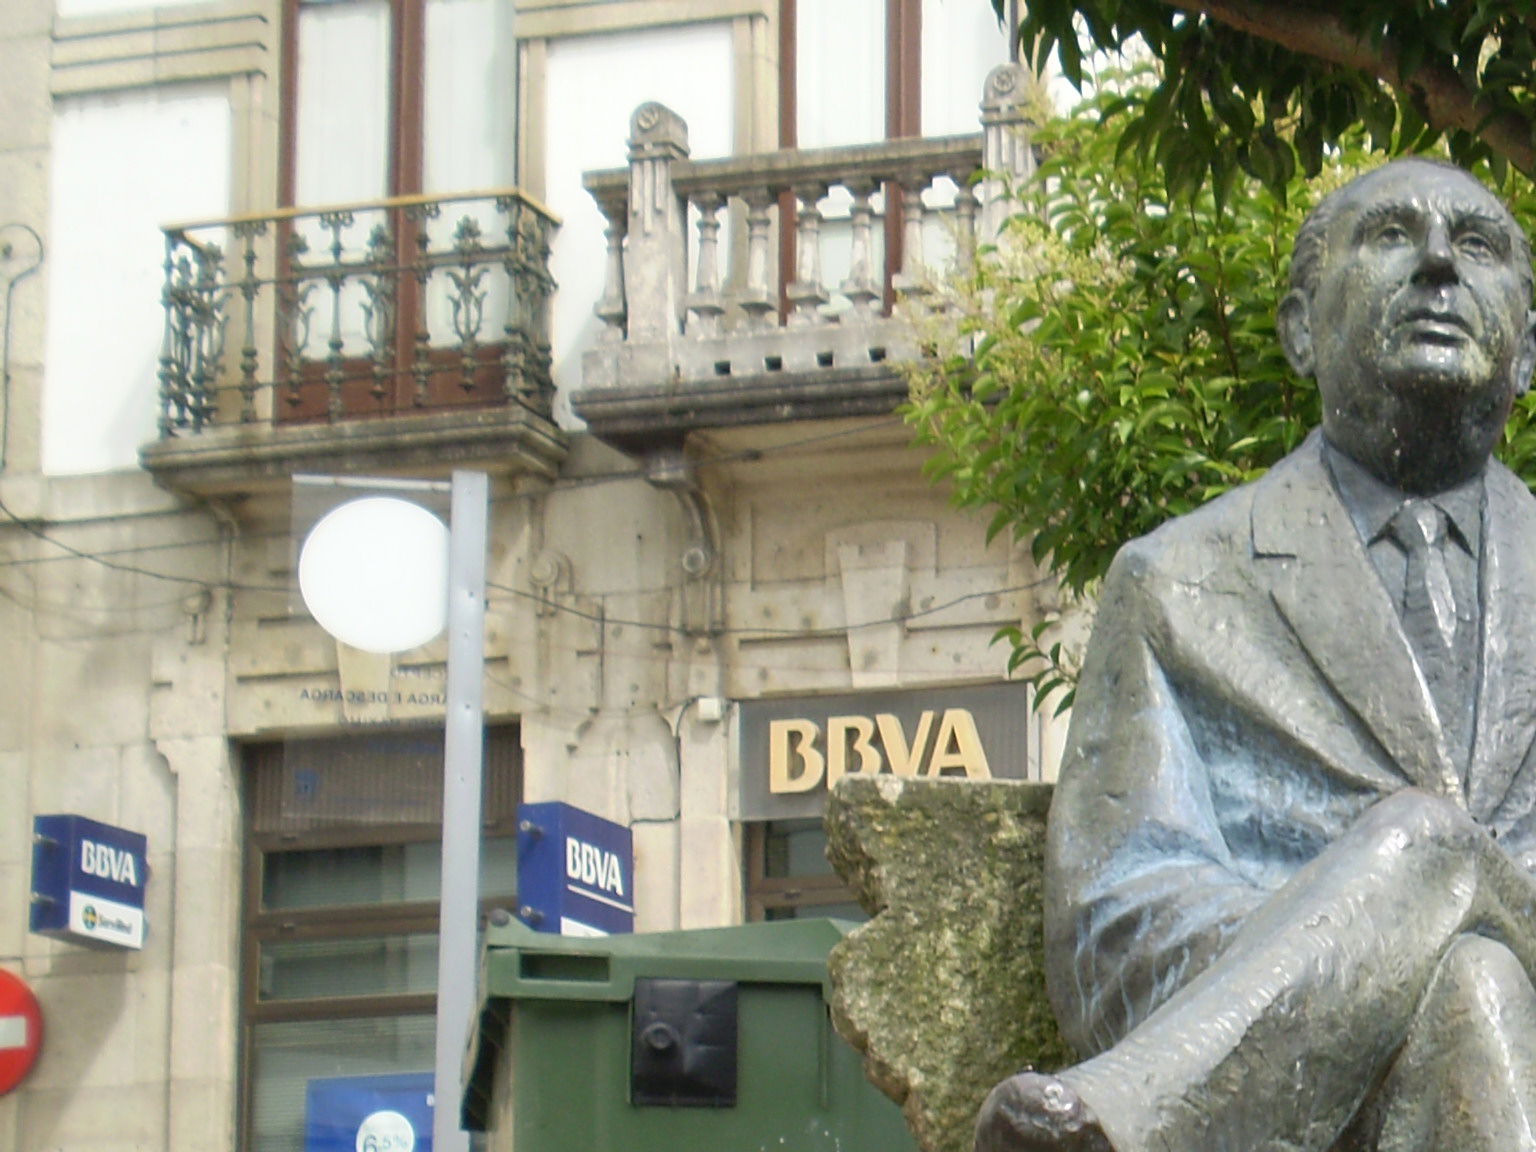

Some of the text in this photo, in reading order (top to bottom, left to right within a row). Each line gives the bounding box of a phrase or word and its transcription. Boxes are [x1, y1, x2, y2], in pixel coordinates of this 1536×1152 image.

[769, 708, 993, 792] BBVA
[81, 838, 137, 887] BBVA
[566, 836, 623, 896] BBVA
